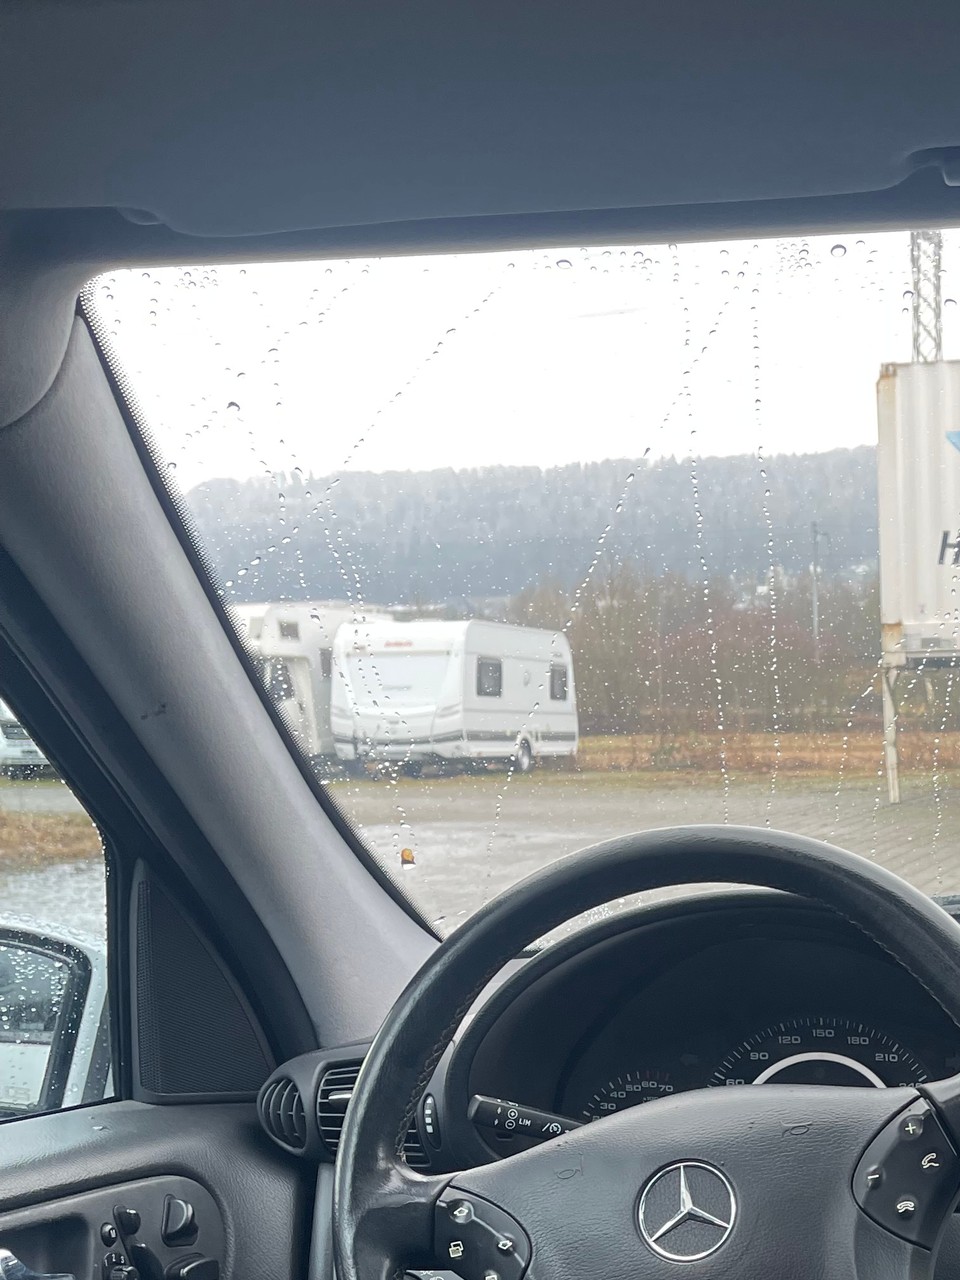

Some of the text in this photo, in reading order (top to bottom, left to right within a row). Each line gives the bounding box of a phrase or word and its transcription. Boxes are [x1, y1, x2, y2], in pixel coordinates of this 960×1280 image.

[812, 1029, 835, 1037] 150
[778, 1035, 801, 1044] 120
[847, 1036, 869, 1045] 180
[750, 1052, 769, 1060] 90
[875, 1053, 898, 1062] 210
[625, 1084, 642, 1092] 50
[600, 1102, 617, 1110] 30
[518, 1118, 532, 1127] LIM
